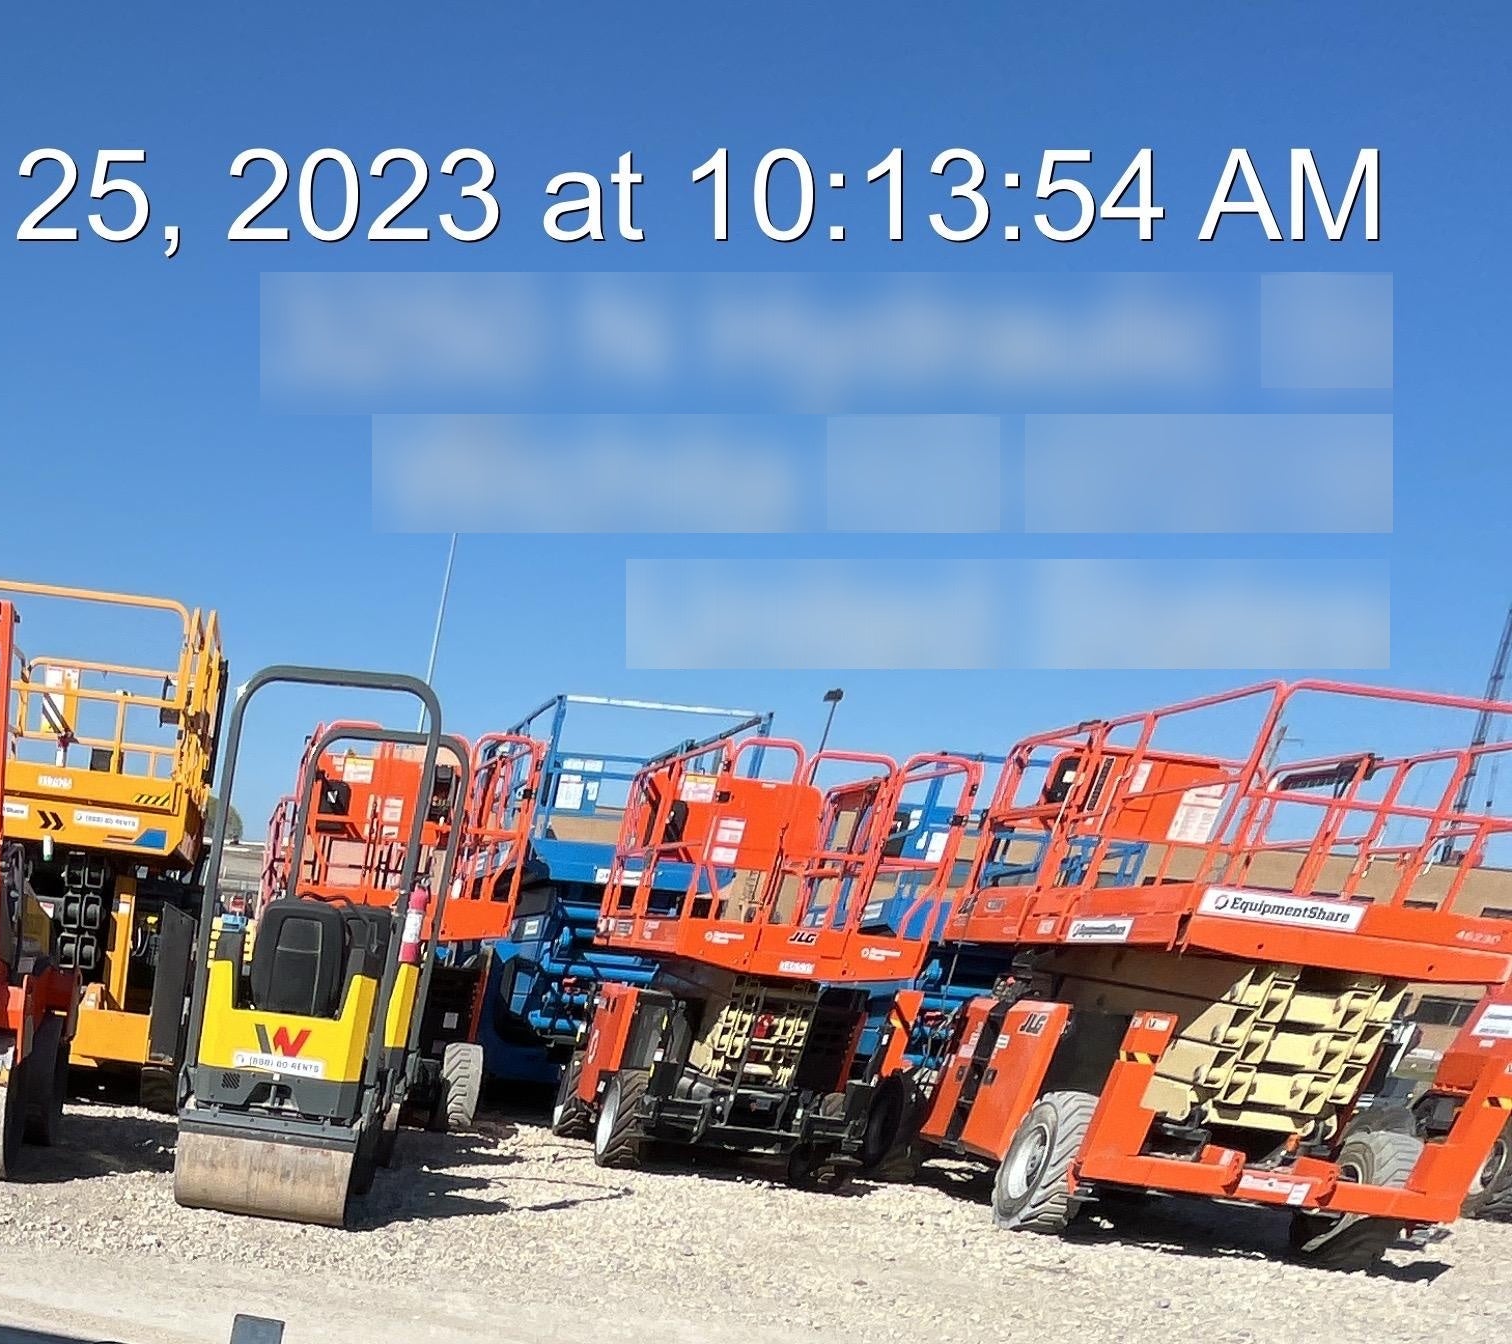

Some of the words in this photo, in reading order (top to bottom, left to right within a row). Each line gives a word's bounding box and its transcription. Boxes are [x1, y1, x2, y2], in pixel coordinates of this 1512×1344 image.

[1230, 896, 1351, 924] EquipmentShare
[789, 931, 817, 944] JLG
[1020, 1011, 1048, 1036] JLG
